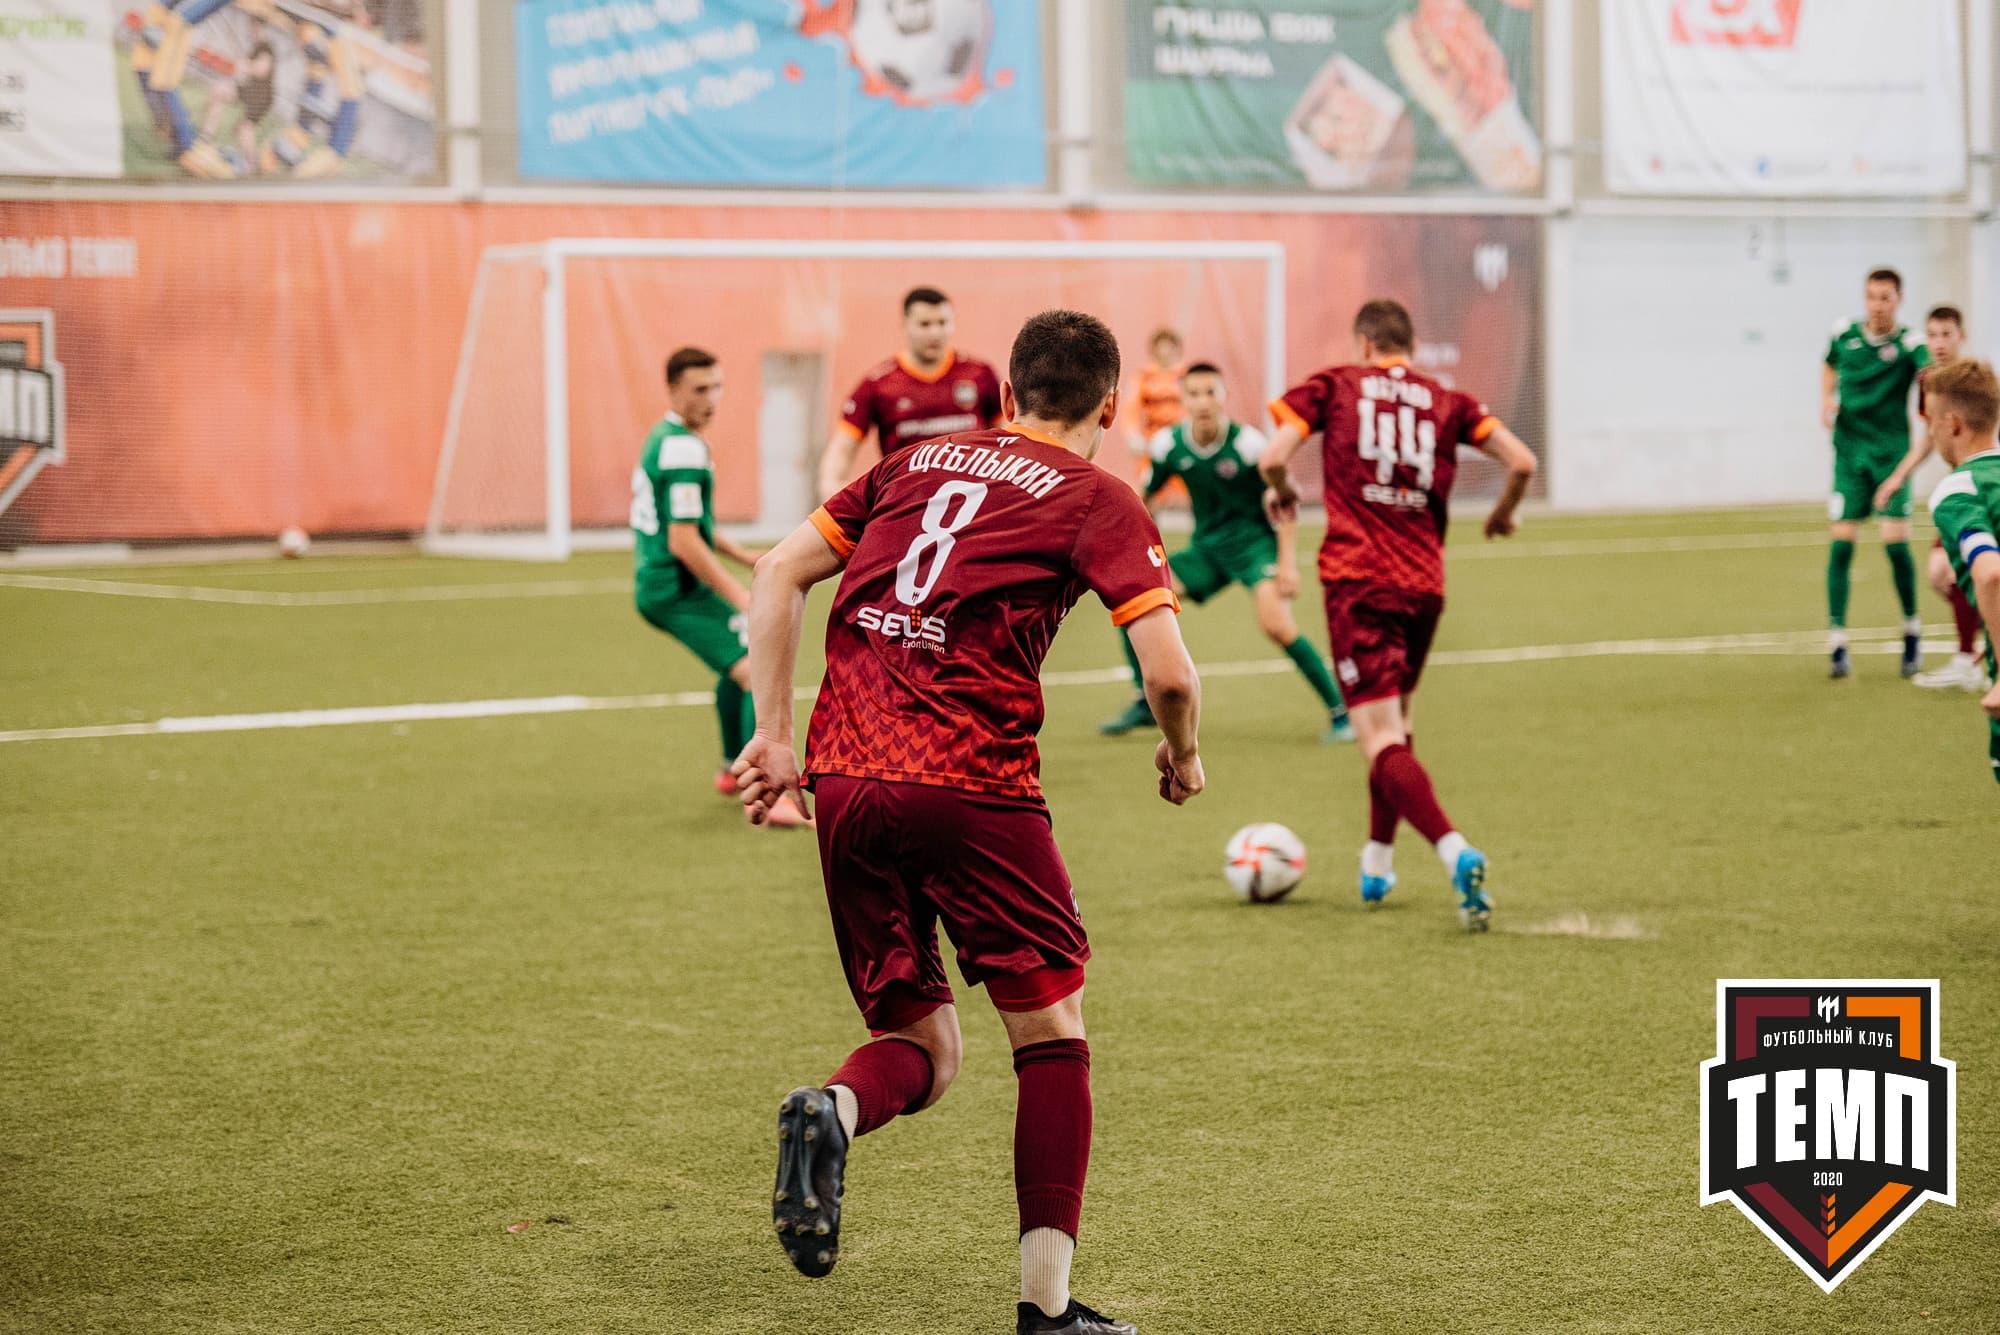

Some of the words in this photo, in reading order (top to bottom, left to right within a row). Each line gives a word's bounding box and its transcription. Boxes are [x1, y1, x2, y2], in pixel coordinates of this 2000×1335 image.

[909, 442, 1066, 500] ЩЕБЛЫКИН
[1357, 398, 1436, 491] 44
[895, 480, 989, 606] 8
[856, 607, 947, 643] SEUS
